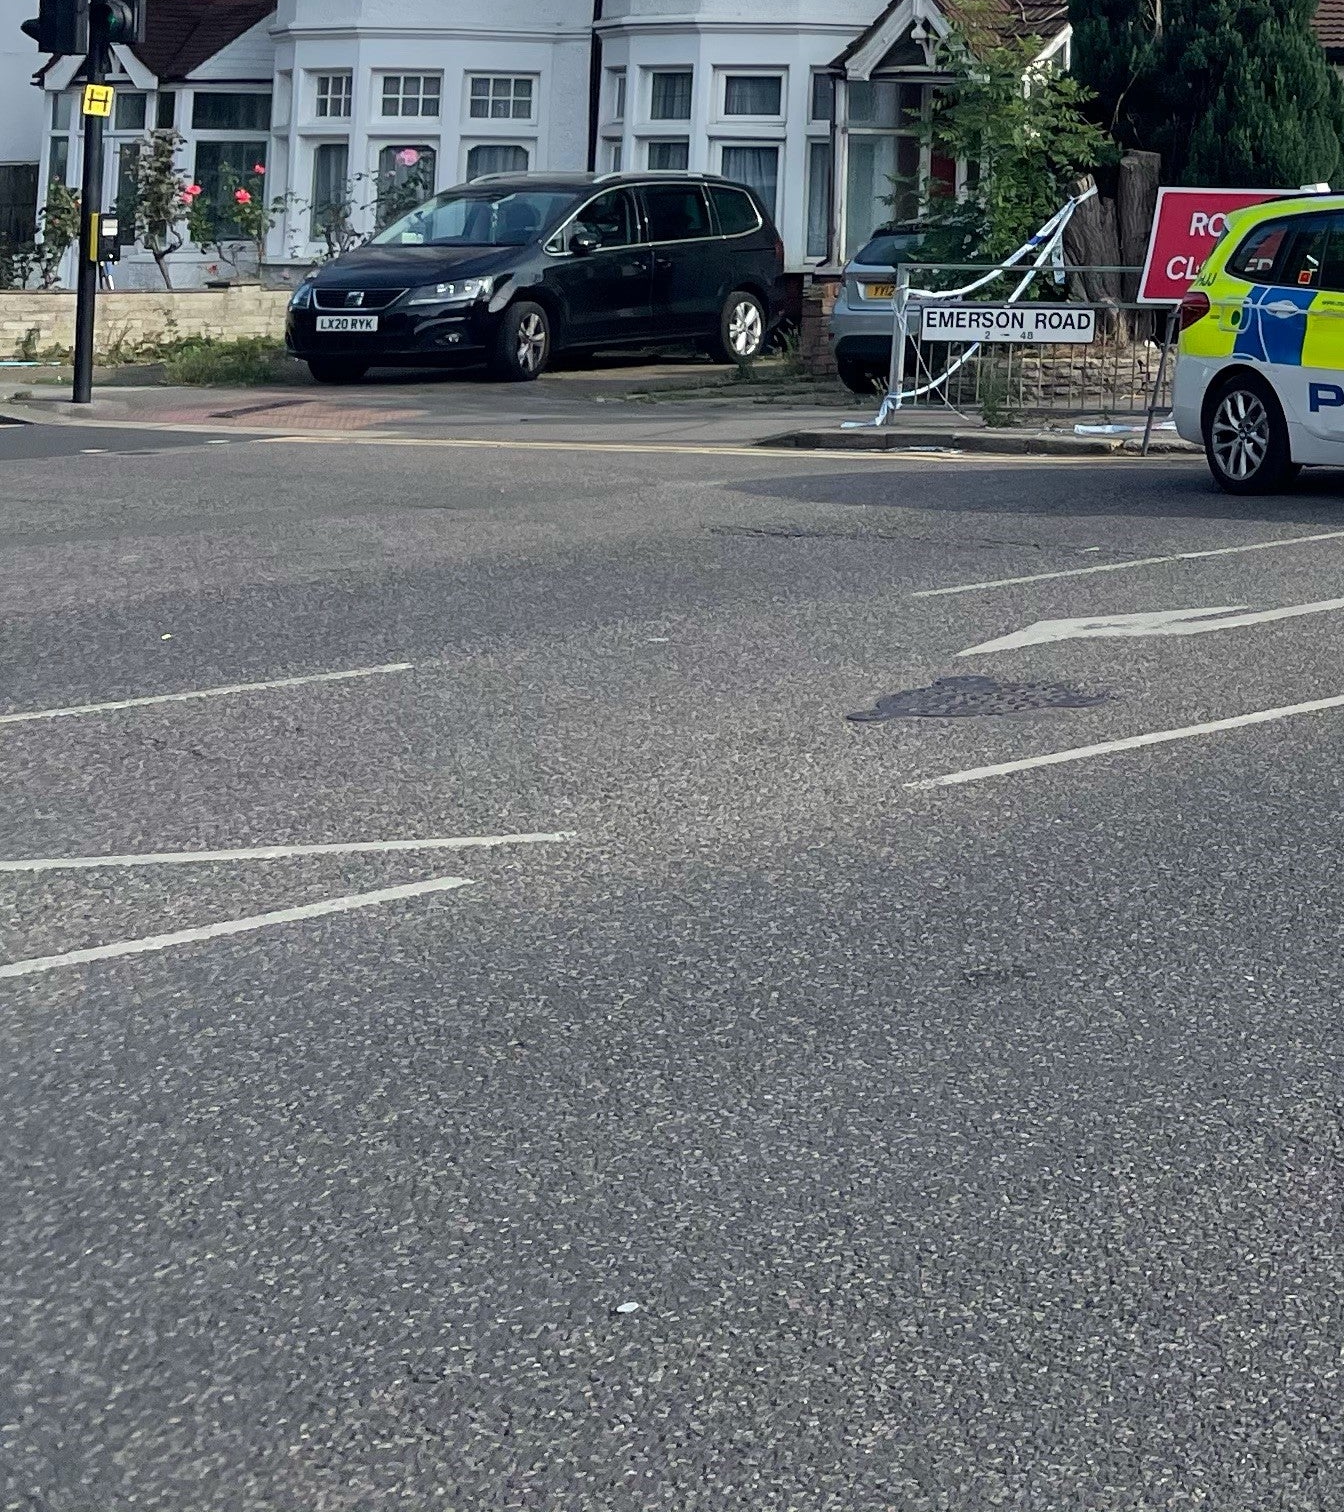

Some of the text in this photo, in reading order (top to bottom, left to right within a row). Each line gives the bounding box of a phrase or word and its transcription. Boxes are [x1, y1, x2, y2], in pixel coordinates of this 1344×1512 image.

[320, 318, 373, 330] LX20 RYK
[926, 311, 1091, 330] EMERSON ROAD
[984, 331, 991, 339] 2
